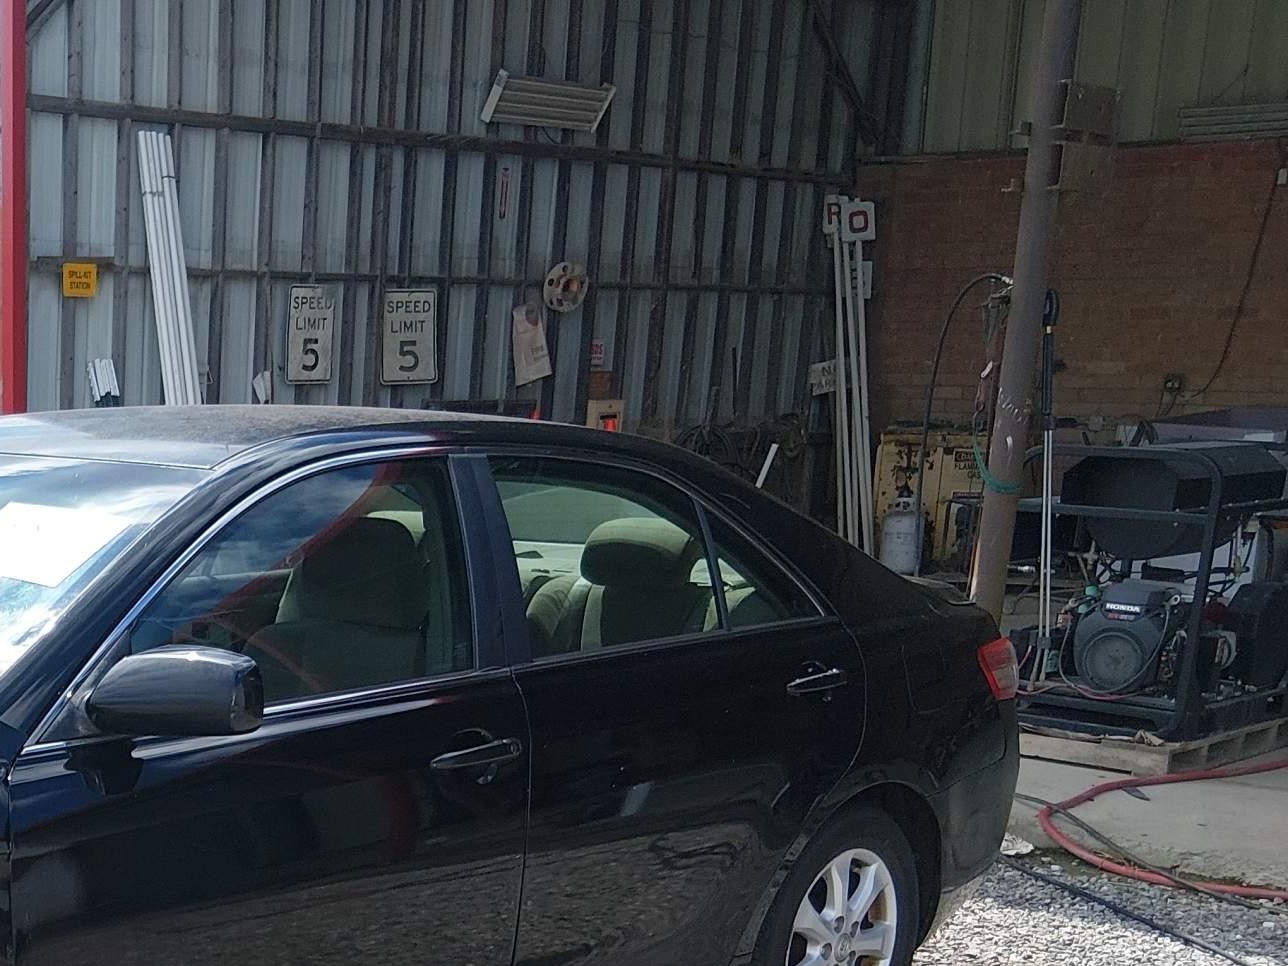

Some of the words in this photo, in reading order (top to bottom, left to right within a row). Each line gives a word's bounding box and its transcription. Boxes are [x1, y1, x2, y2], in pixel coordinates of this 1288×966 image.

[69, 281, 91, 290] STATION
[293, 296, 333, 311] SPEED
[386, 300, 431, 314] SPEED
[295, 317, 328, 331] LIMIT
[390, 320, 426, 334] LIMIT
[301, 338, 319, 372] 5
[398, 340, 420, 373] 5
[1105, 602, 1141, 613] HONDA
